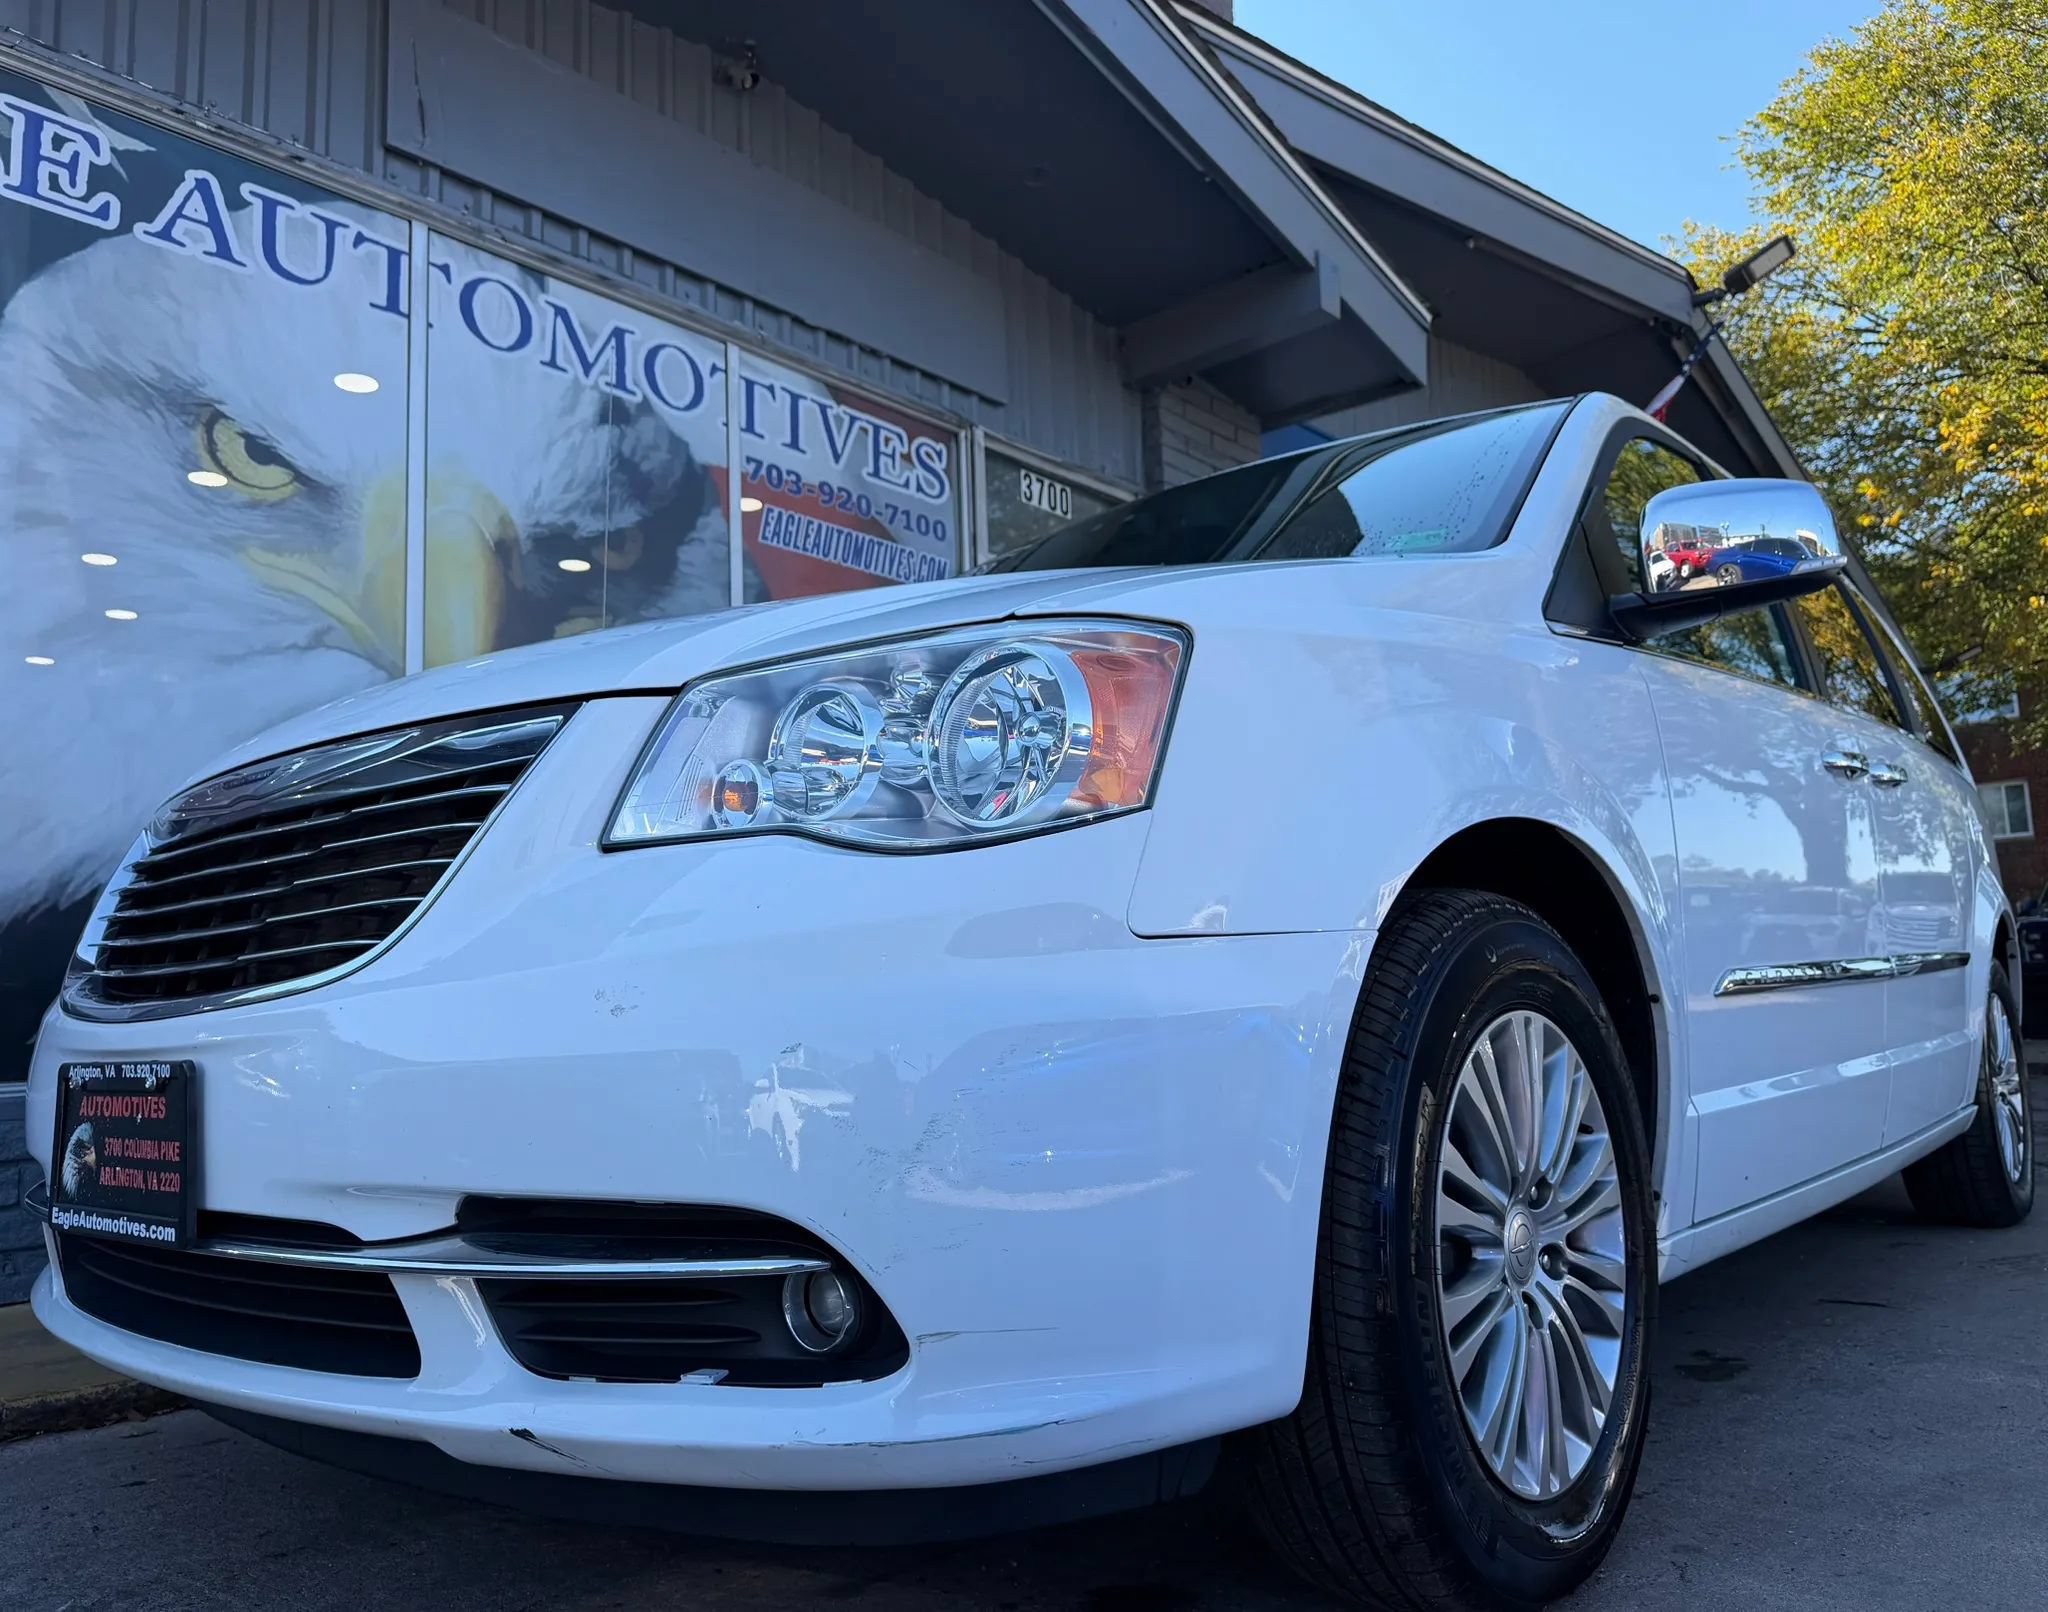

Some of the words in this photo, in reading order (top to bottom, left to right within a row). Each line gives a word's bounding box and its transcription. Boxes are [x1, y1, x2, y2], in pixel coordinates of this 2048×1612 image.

[0, 94, 119, 229] E
[136, 172, 951, 502] AUTOMOTIVES
[744, 455, 947, 543] 703-920-7100
[1021, 471, 1070, 517] 3700
[760, 506, 948, 583] EAGLEAUTOMOTIVES.COM
[1744, 962, 1842, 985] CHRYSLER
[104, 1065, 116, 1079] VA
[79, 1095, 167, 1120] AUTOMOTIVES
[123, 1139, 159, 1161] COLUMBIA
[160, 1141, 181, 1162] PIKE
[147, 1171, 158, 1190] VA
[51, 1206, 176, 1242] EagleAutomotives.com
